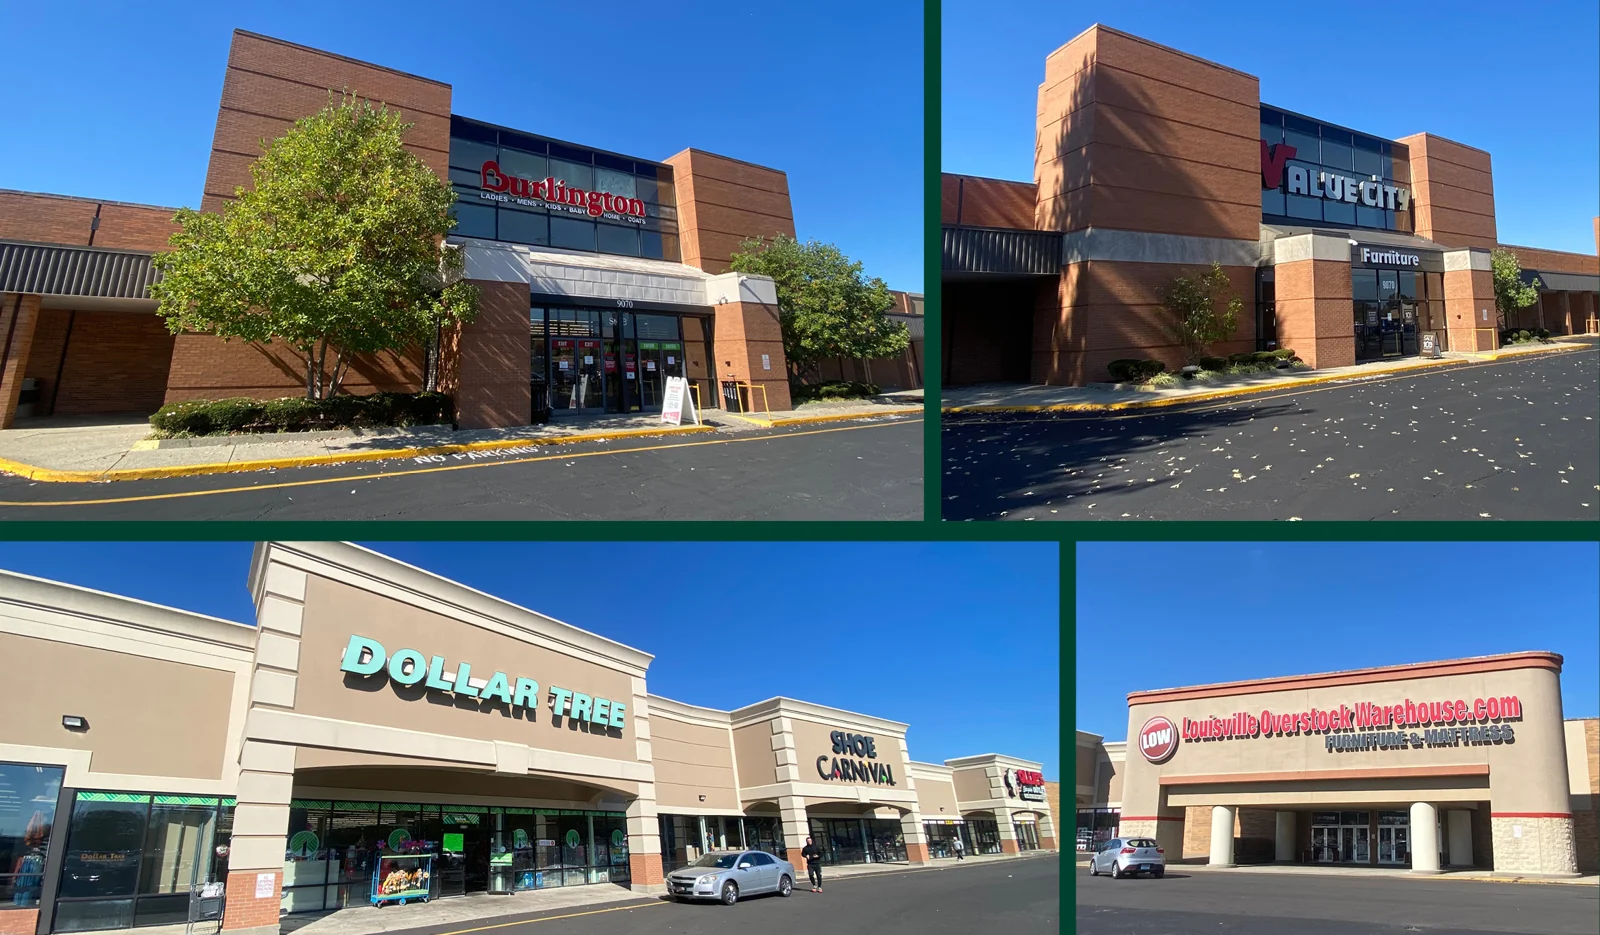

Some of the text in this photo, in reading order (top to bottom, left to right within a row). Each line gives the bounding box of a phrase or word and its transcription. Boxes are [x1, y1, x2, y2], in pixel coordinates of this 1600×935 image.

[480, 160, 647, 217] Burlington
[1261, 139, 1411, 212] VALUE CITY
[480, 192, 647, 225] LADIES MENS KIDS BABY HOME COATS
[1362, 248, 1419, 265] Furniture
[616, 299, 634, 309] 9070
[452, 446, 538, 460] PARKING
[340, 634, 627, 729] DOLLAR TREE
[1182, 695, 1521, 740] Louisville Overstock Warehouse.com
[830, 730, 877, 759] SHOE
[1142, 726, 1173, 749] LOW
[1325, 725, 1514, 750] FURNITURE & MATTRESS
[816, 754, 897, 787] CARNIVAL
